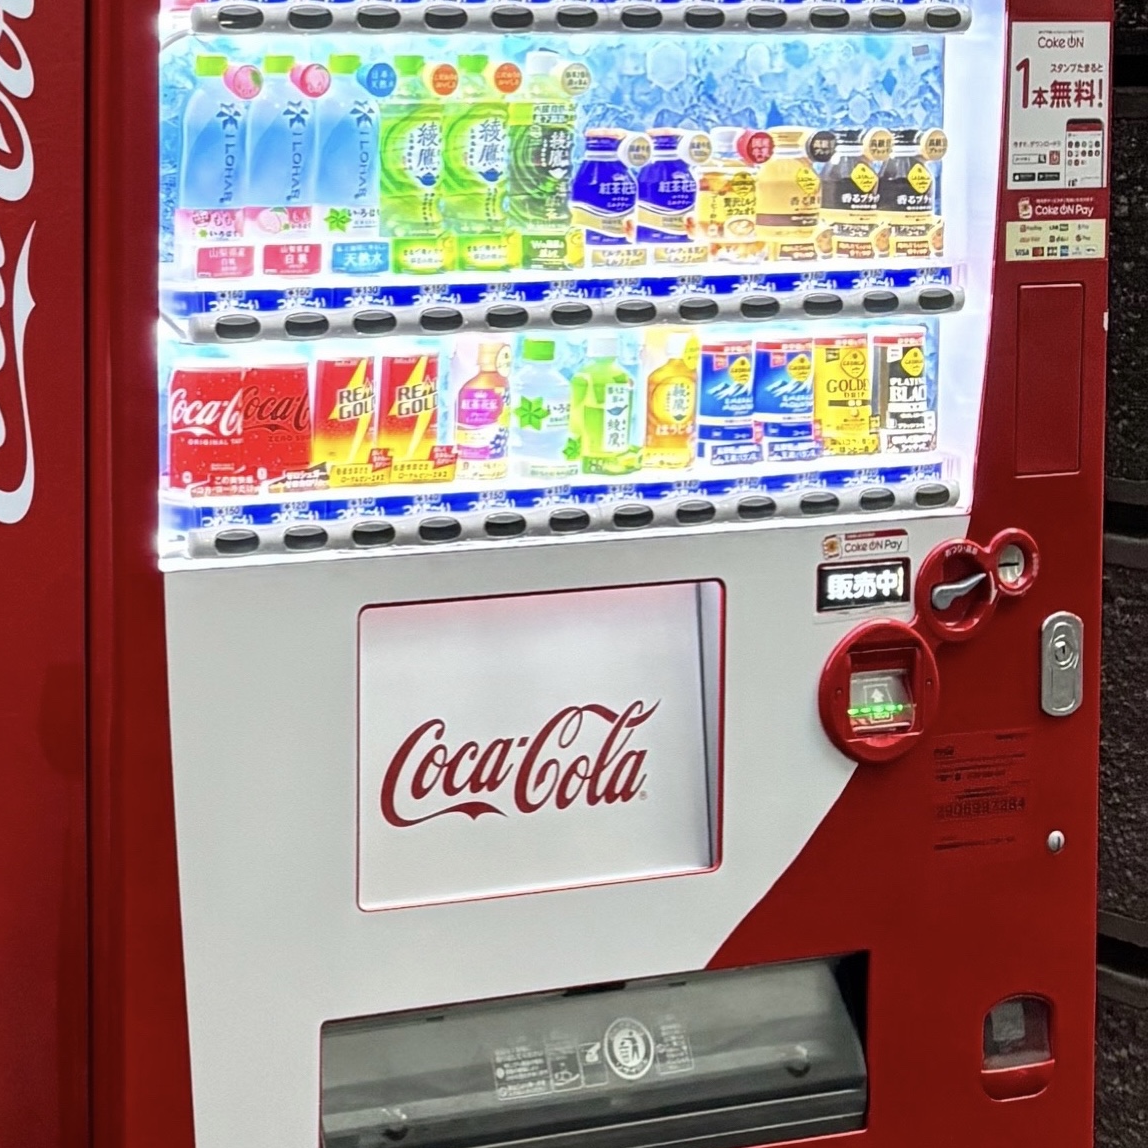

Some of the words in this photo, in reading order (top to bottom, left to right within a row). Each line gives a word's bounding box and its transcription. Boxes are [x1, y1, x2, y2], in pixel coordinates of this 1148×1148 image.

[1038, 36, 1065, 48] Coke
[1067, 34, 1084, 48] ON
[1050, 64, 1103, 73] スタンプたまると
[417, 122, 439, 171] 綾鷹
[479, 118, 502, 168] 綾鷹
[243, 385, 310, 433] Coca-C
[884, 539, 902, 551] Pay
[827, 569, 898, 600] 販売中
[380, 699, 661, 828] Coca-Cola
